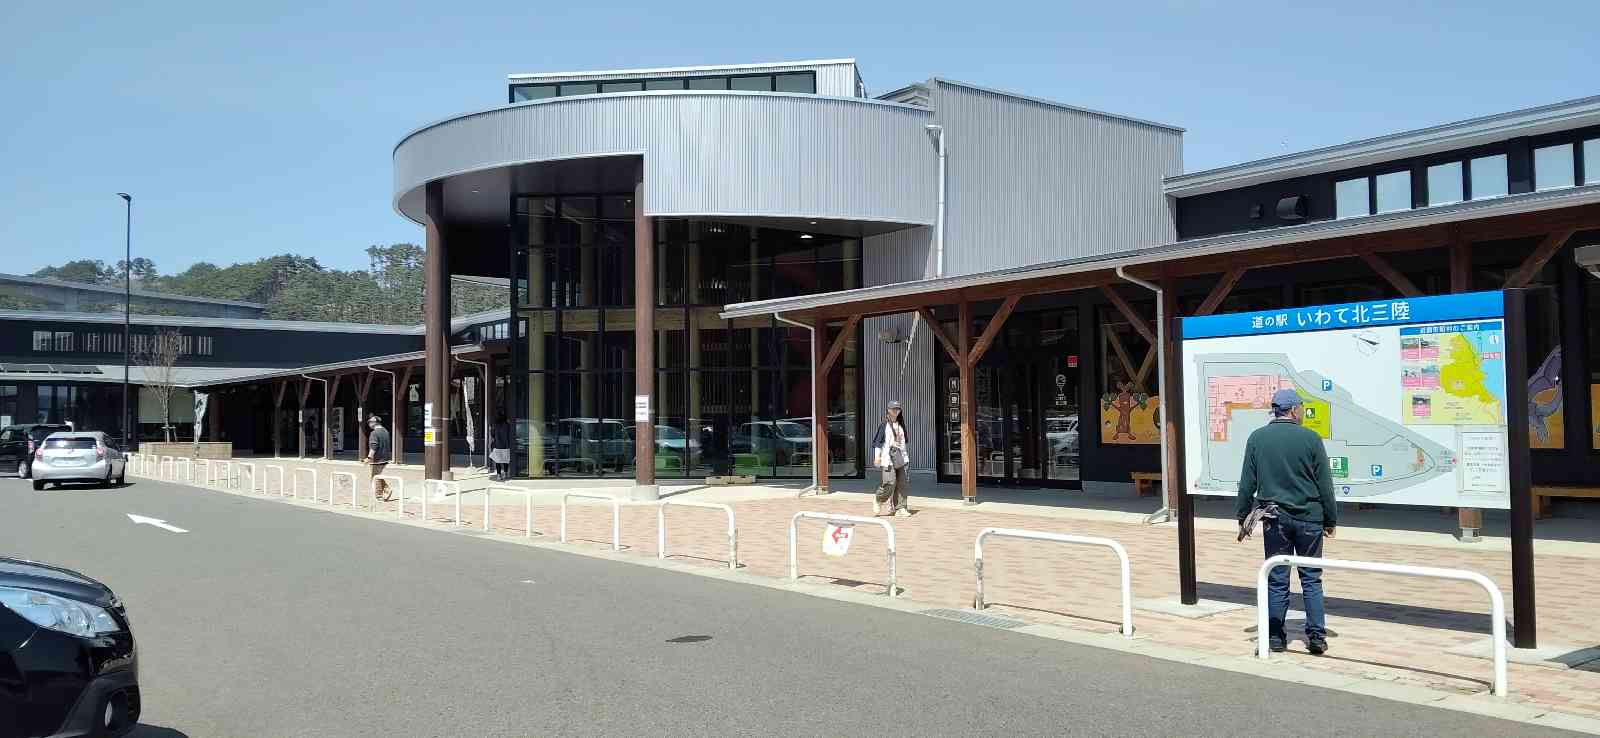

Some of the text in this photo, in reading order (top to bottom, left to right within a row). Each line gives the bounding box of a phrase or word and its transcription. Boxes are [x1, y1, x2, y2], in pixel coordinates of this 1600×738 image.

[1252, 301, 1410, 329] 道の駅 いわて北三陸
